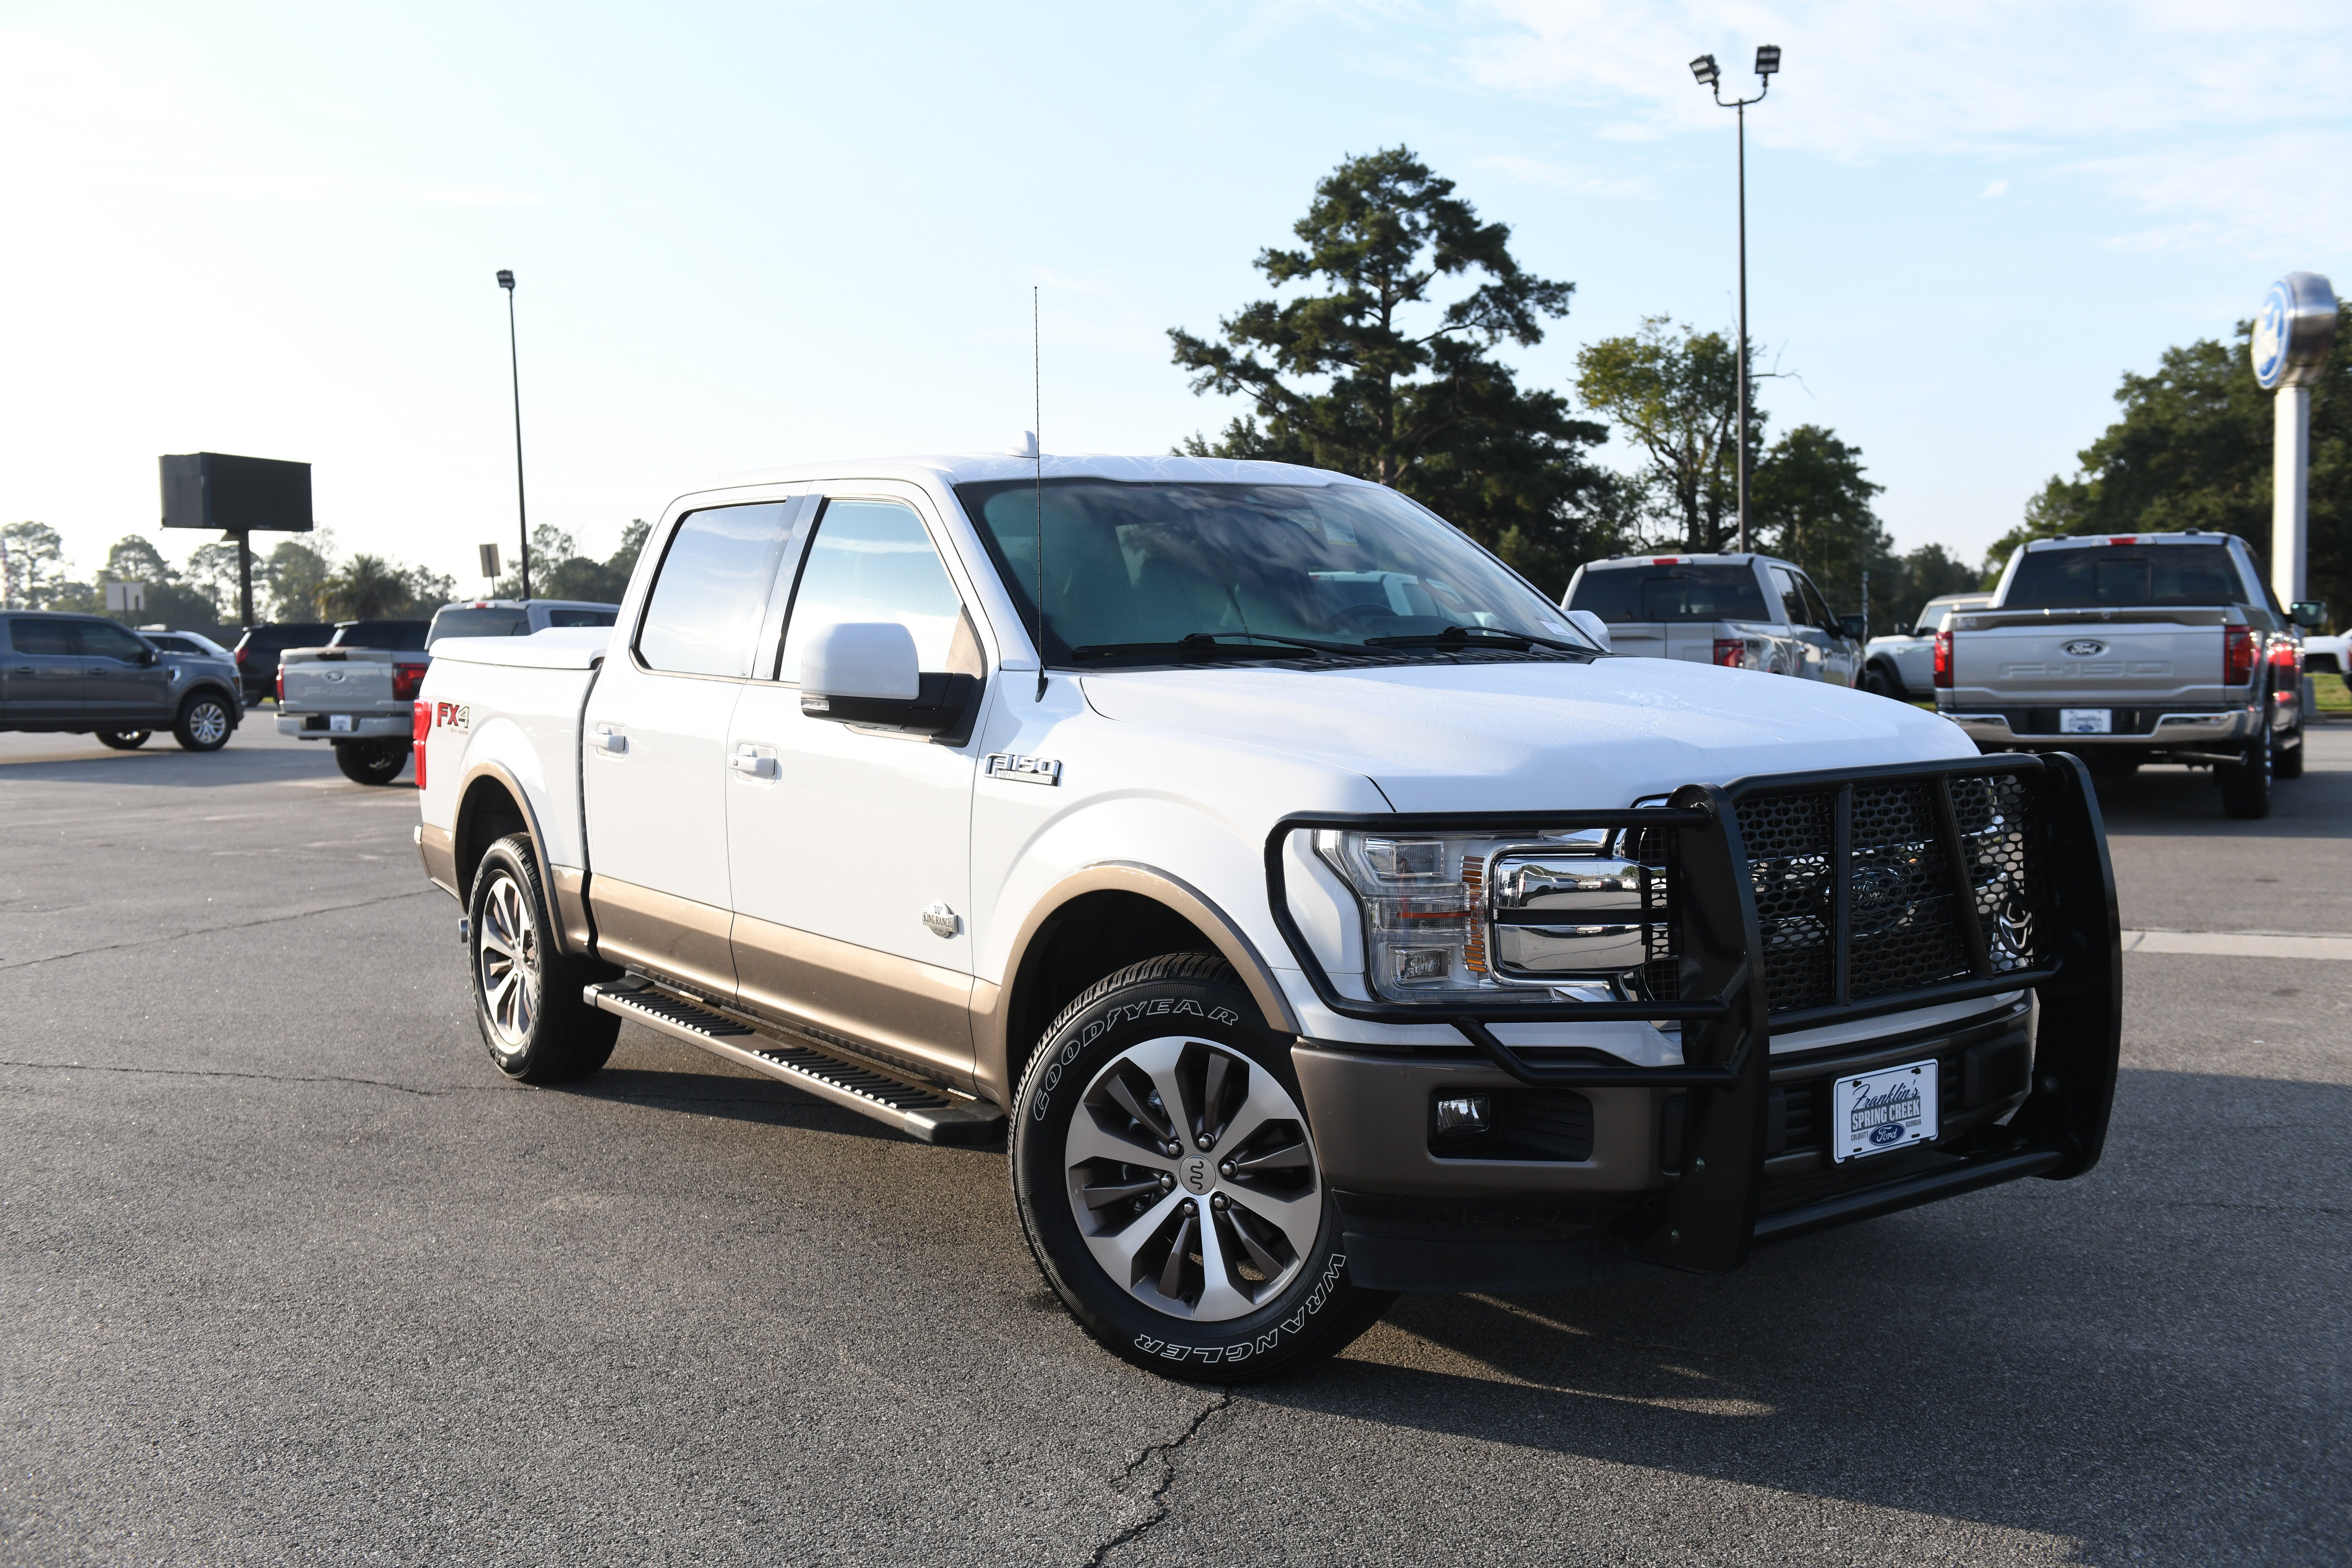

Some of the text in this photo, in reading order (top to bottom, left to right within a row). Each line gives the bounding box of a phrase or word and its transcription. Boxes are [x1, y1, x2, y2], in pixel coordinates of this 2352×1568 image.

[2000, 660, 2174, 679] F-150
[437, 702, 470, 728] FX4
[923, 911, 952, 928] KING RANCH
[1033, 998, 1239, 1121] GOODYEAR
[1852, 1078, 1920, 1113] Franklin's
[1852, 1099, 1920, 1130] SPRING CREEK
[1906, 1119, 1922, 1128] GEORGIA
[1851, 1131, 1869, 1141] COLQUITT
[1876, 1126, 1898, 1142] Ford
[1134, 1254, 1346, 1363] WRANGLER
